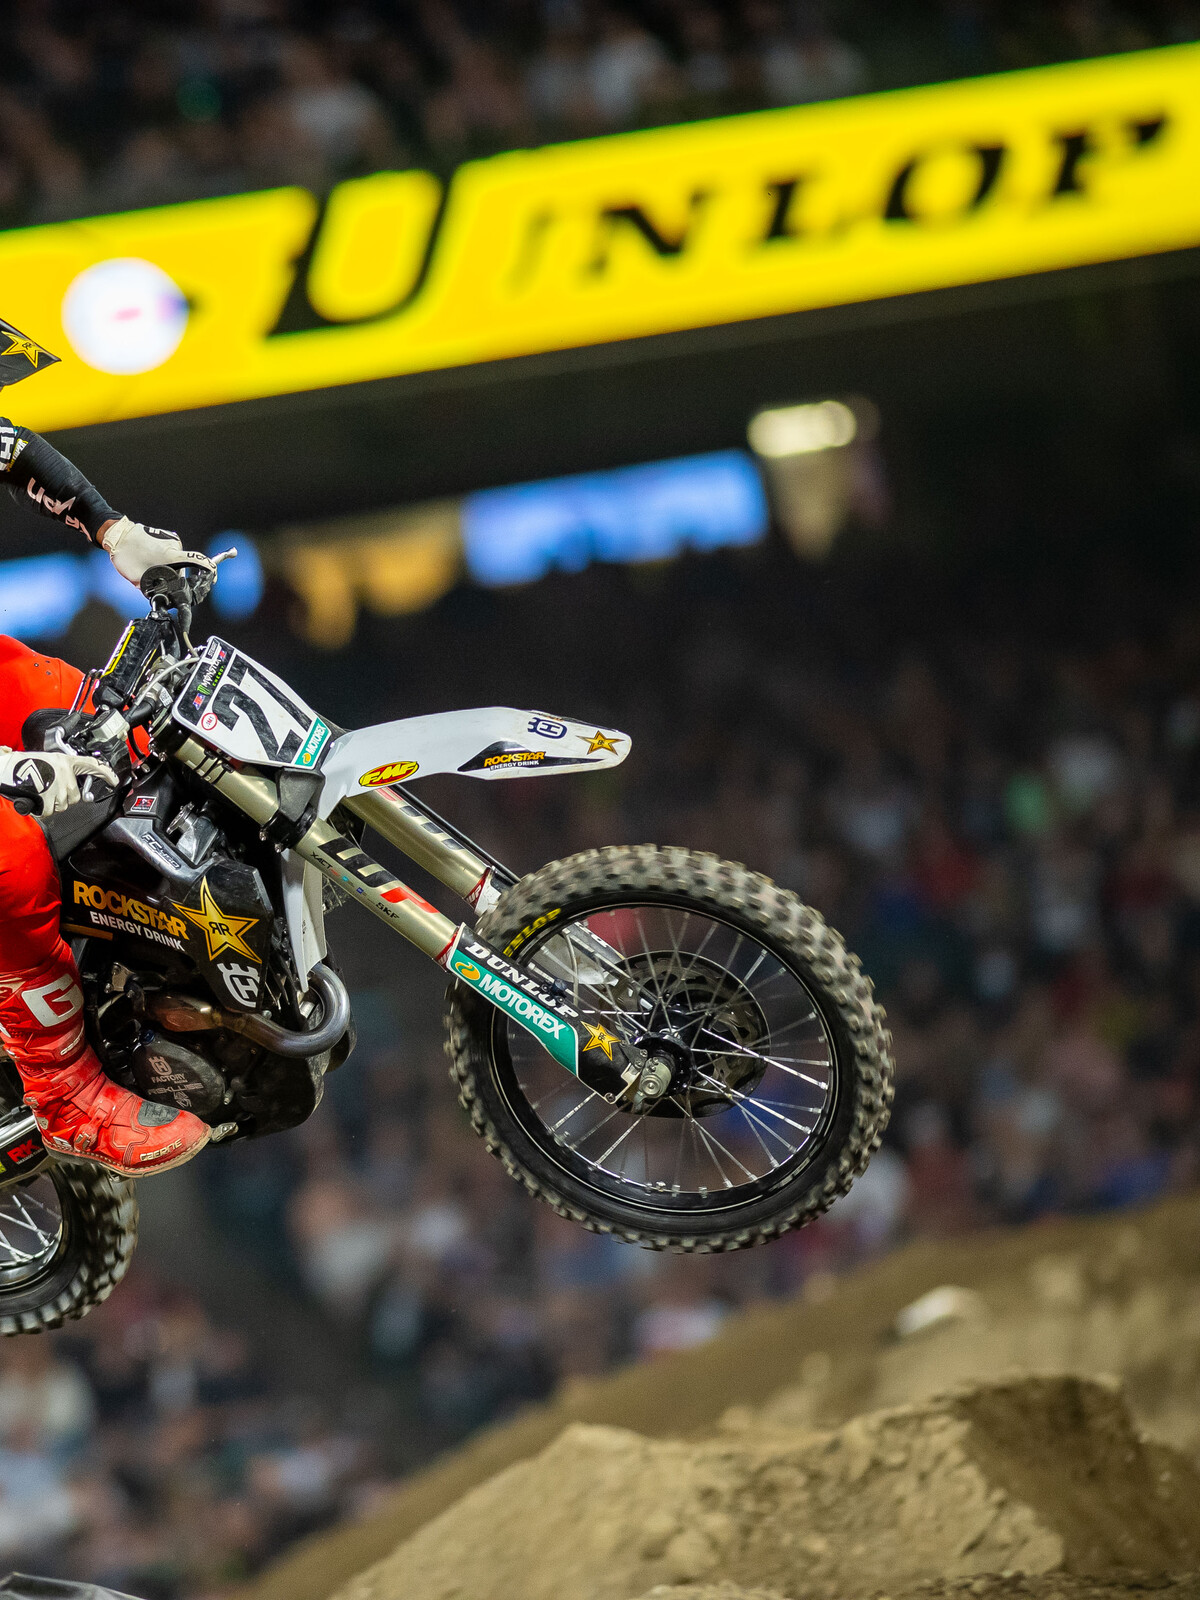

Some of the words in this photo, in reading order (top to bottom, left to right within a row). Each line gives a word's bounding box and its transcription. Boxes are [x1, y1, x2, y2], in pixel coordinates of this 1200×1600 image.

[211, 653, 313, 764] 27
[305, 722, 327, 755] MOTOREX
[483, 751, 547, 768] ROCKSTAR
[490, 761, 517, 771] ENERGY
[517, 759, 540, 768] DRINK
[360, 761, 418, 787] FMF
[310, 851, 333, 870] XACT
[73, 880, 190, 941] ROCKSTAR
[375, 902, 400, 920] SKF
[89, 911, 142, 936] ENERGY
[143, 926, 186, 953] DRINK
[478, 973, 567, 1040] MOTOREX
[151, 1073, 186, 1084] FACTORY
[7, 1139, 41, 1163] RK
